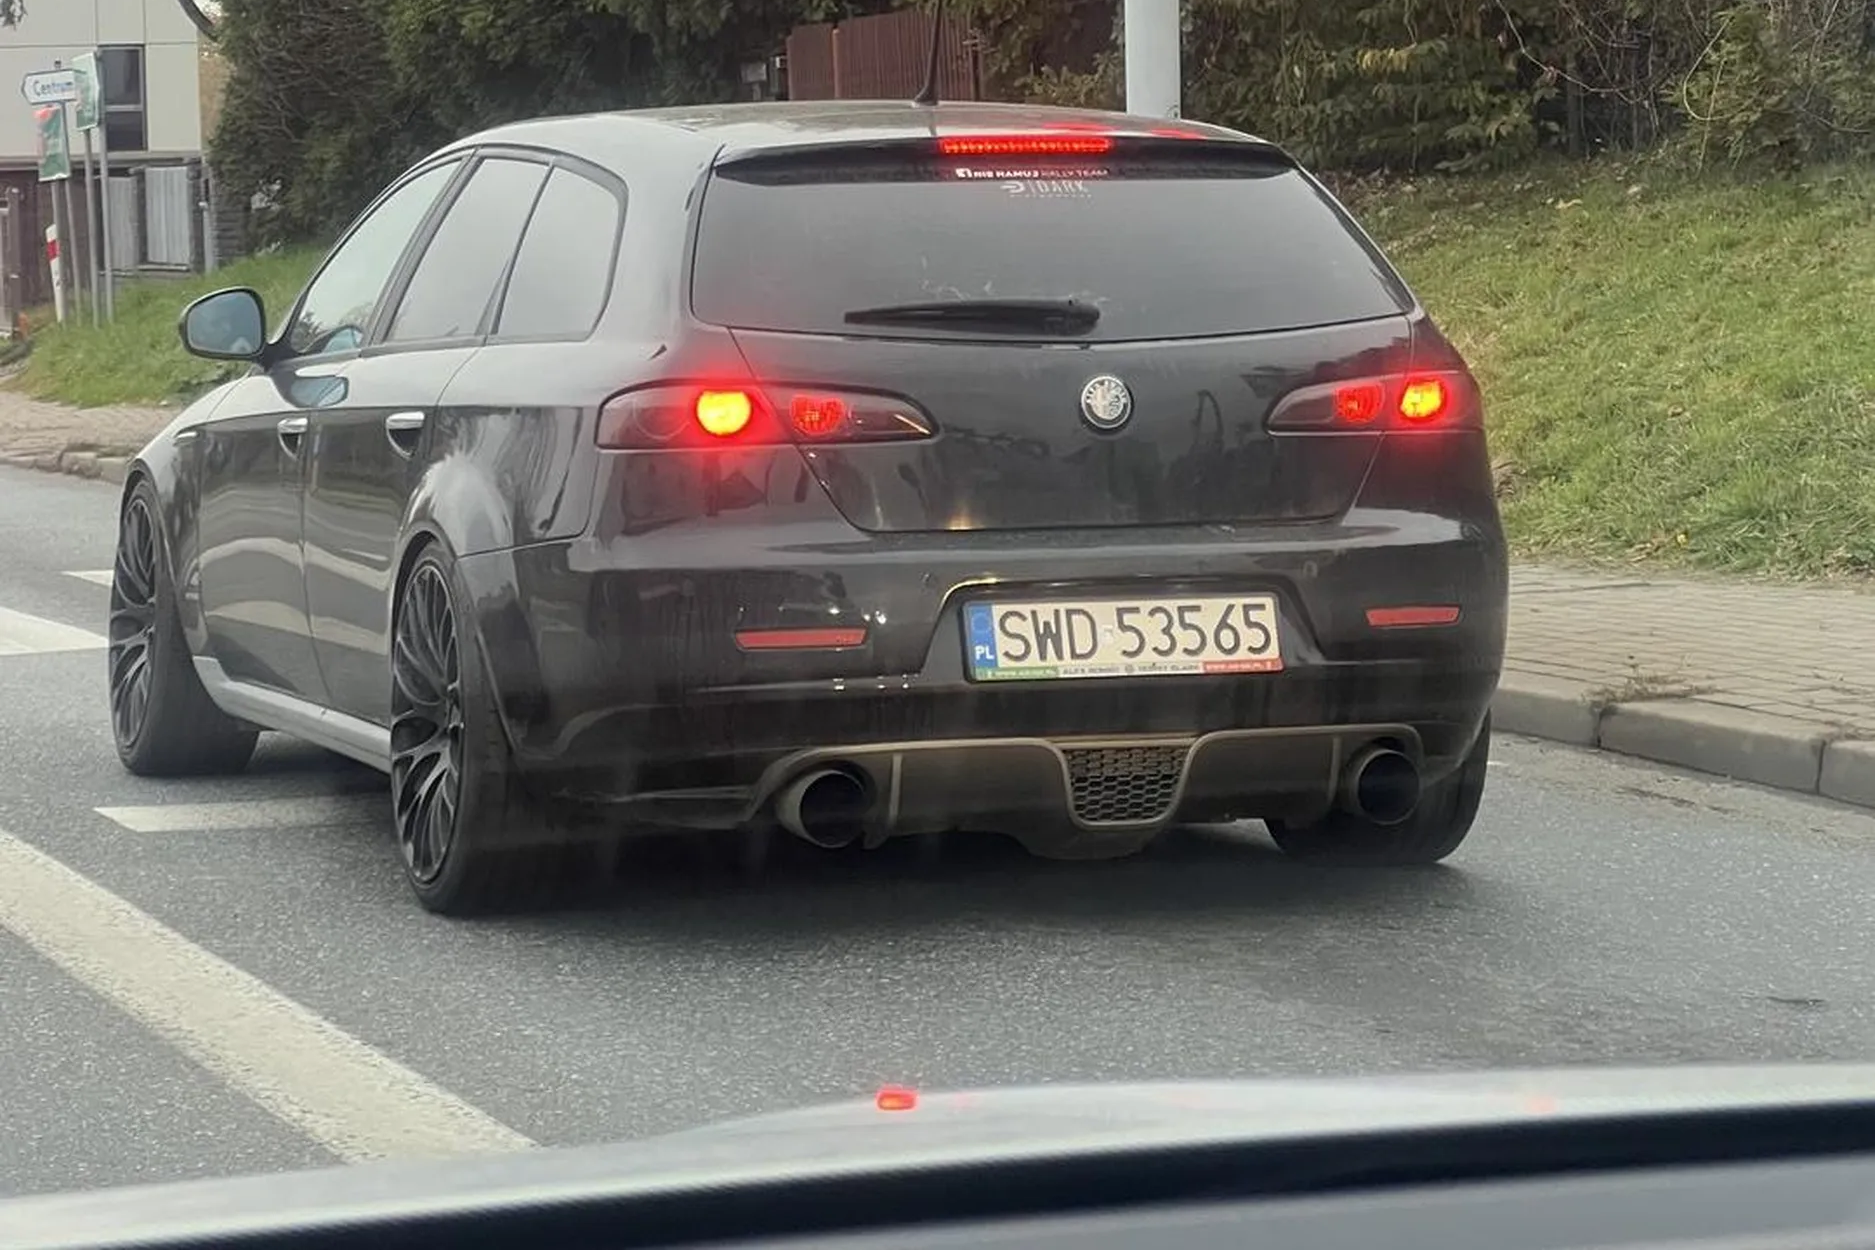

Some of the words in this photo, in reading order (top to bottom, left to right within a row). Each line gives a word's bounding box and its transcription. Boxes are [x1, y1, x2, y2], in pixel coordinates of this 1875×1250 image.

[998, 608, 1099, 662] SWD
[1115, 603, 1272, 659] 53565
[975, 645, 995, 661] PL
